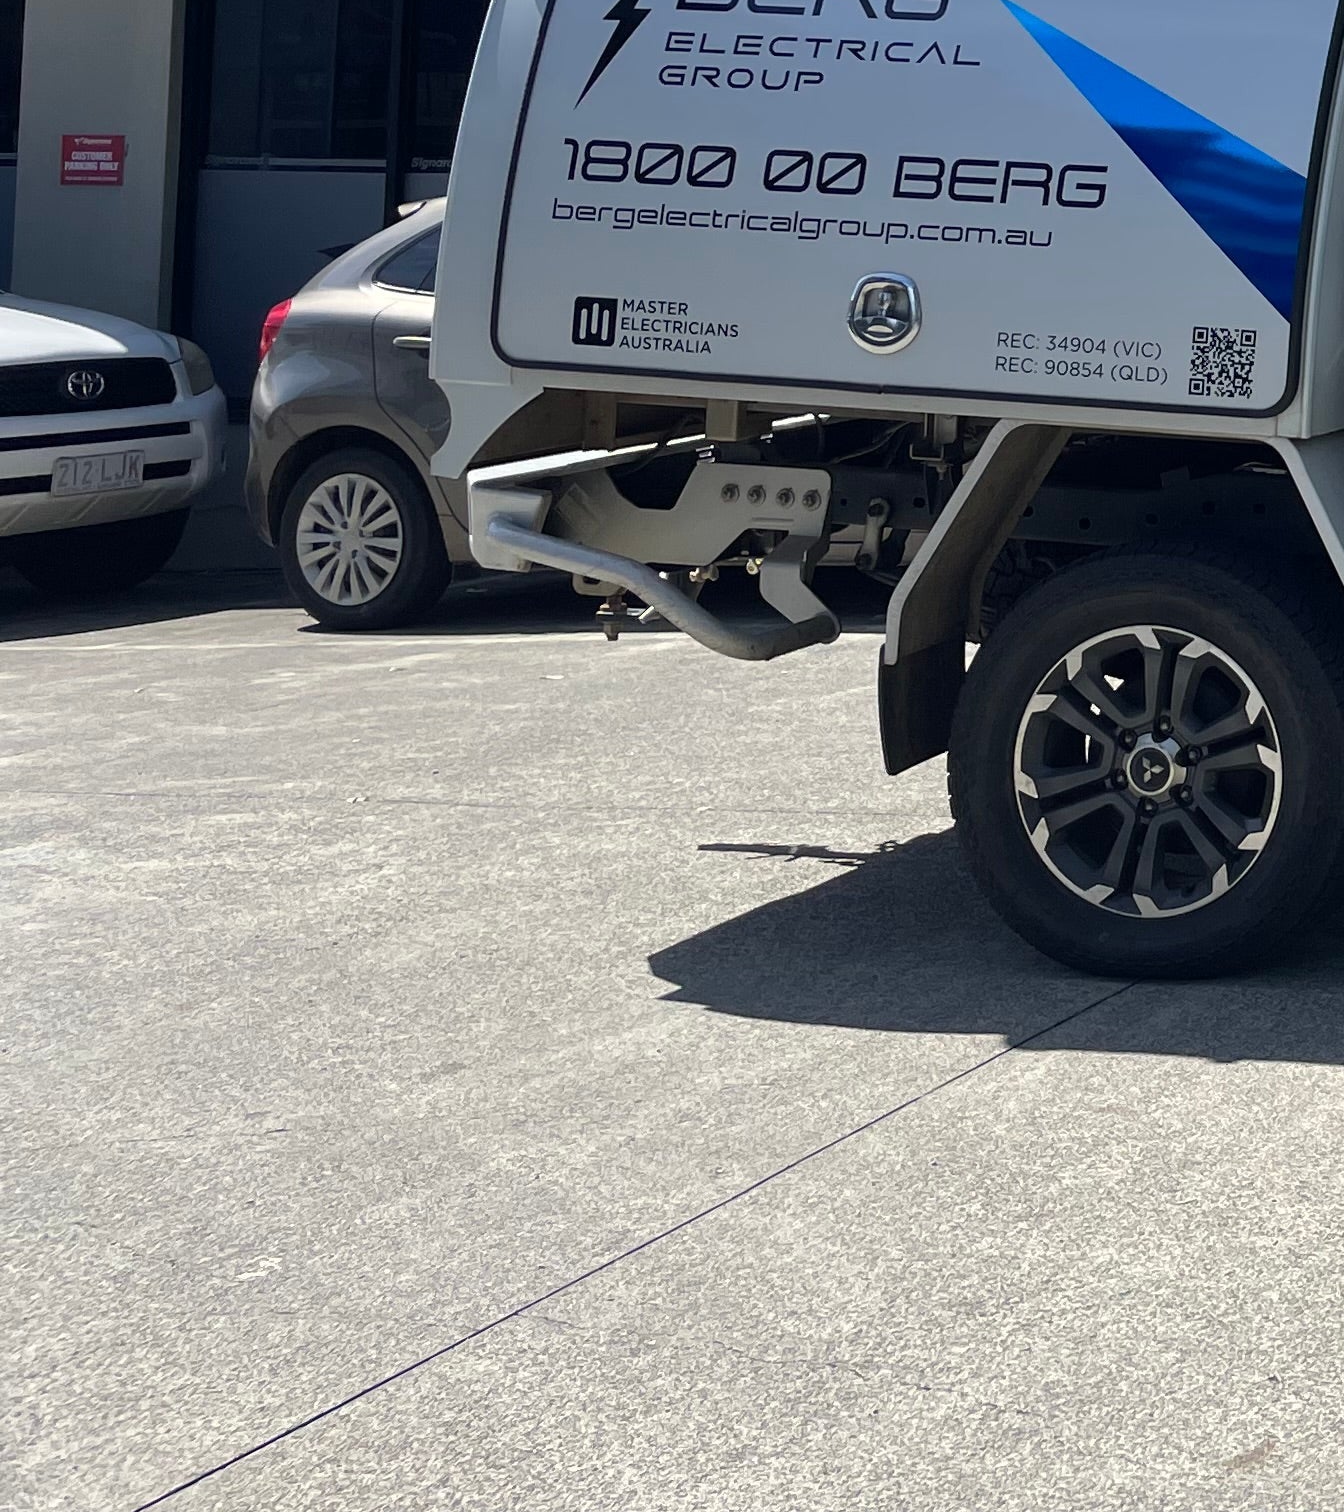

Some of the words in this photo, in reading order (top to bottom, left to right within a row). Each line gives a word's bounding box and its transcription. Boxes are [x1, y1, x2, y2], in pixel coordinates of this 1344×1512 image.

[664, 31, 981, 66] ELECTRICAL
[658, 65, 825, 91] GROUP
[564, 138, 736, 188] 1800
[763, 149, 867, 195] 00
[893, 156, 1108, 209] BERG
[552, 198, 1052, 247] bergelectricalgroup.com.au
[622, 298, 689, 316] MASTER
[621, 317, 739, 337] ELECTRICIANS
[619, 336, 712, 354] AUSTRALIA
[997, 332, 1040, 350] REC:
[1046, 335, 1107, 355] 34904
[1113, 341, 1162, 360] (VIC)
[995, 356, 1038, 374] REC:
[1044, 359, 1104, 379] 90854
[1110, 365, 1168, 385] (QLD)
